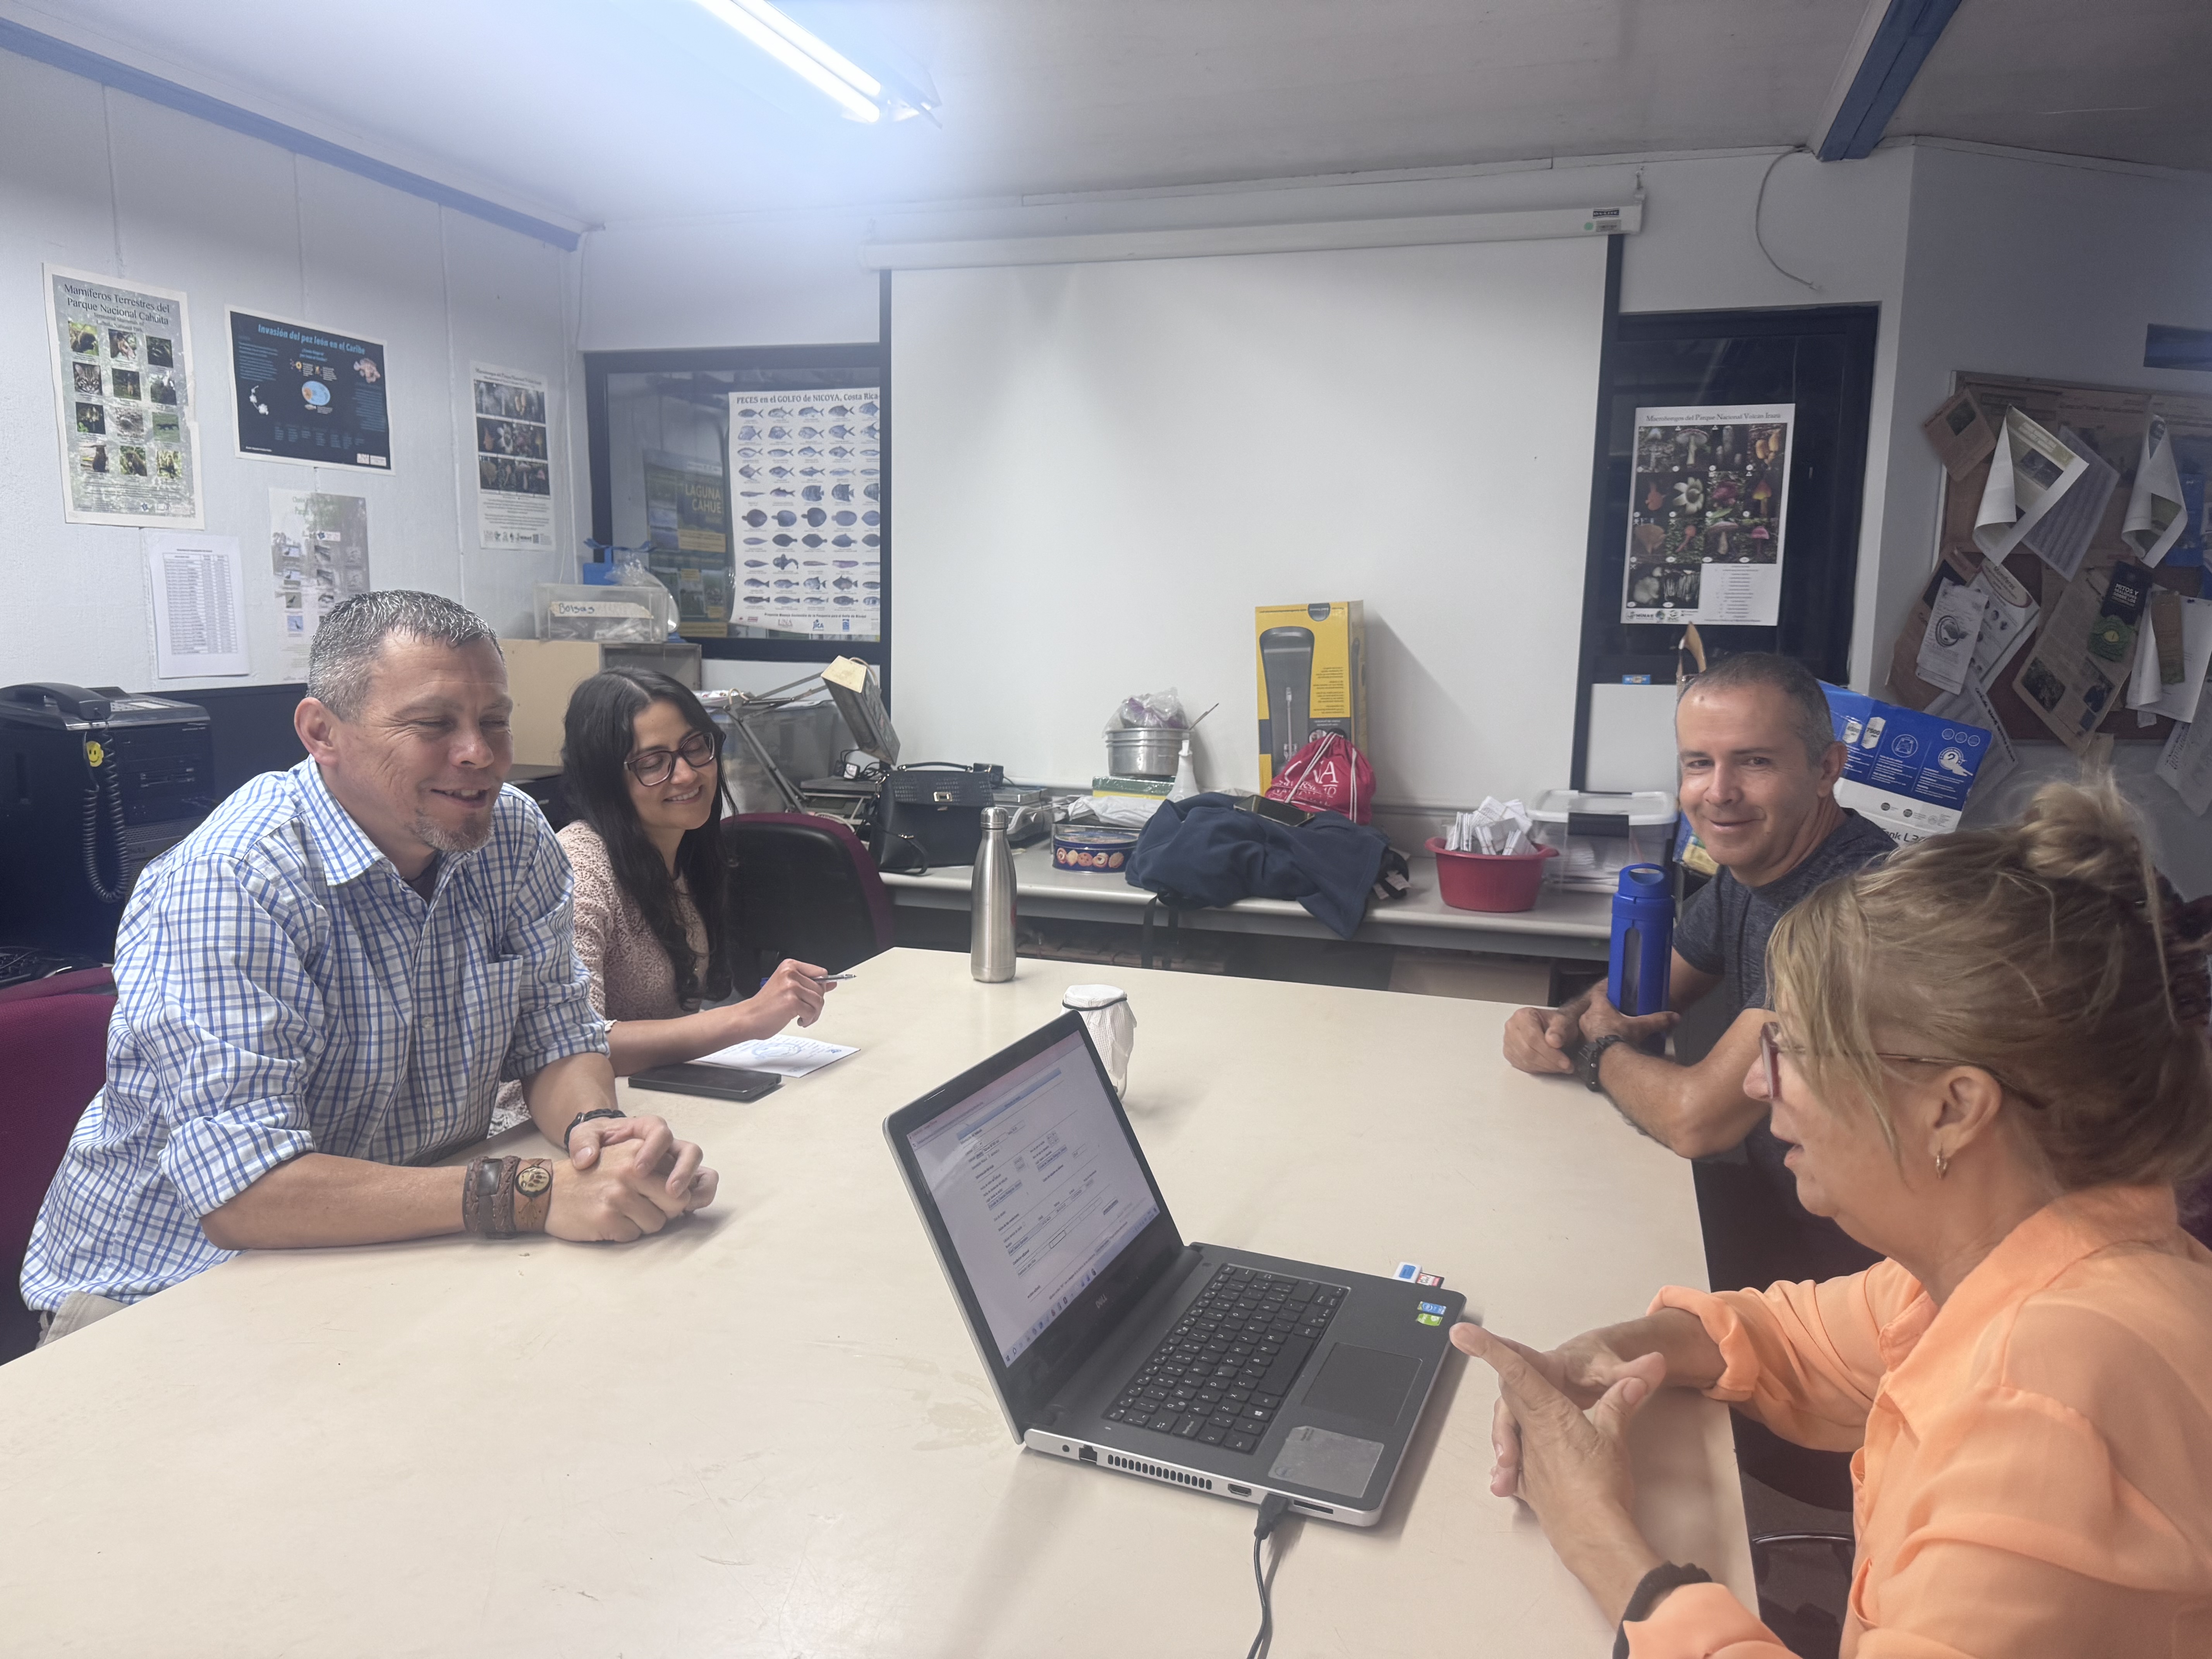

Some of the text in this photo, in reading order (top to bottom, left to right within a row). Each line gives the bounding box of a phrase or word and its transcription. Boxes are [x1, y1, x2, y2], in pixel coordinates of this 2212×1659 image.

[64, 284, 170, 313] Mamíferos Terrestres del
[67, 297, 168, 325] Parque Nacional Cahuita
[258, 324, 288, 338] Invasión
[289, 331, 300, 341] del
[301, 335, 313, 344] pez
[314, 336, 328, 347] león
[777, 395, 801, 403] GOLFO
[843, 393, 862, 401] Costa
[685, 484, 722, 500] LAGUNA
